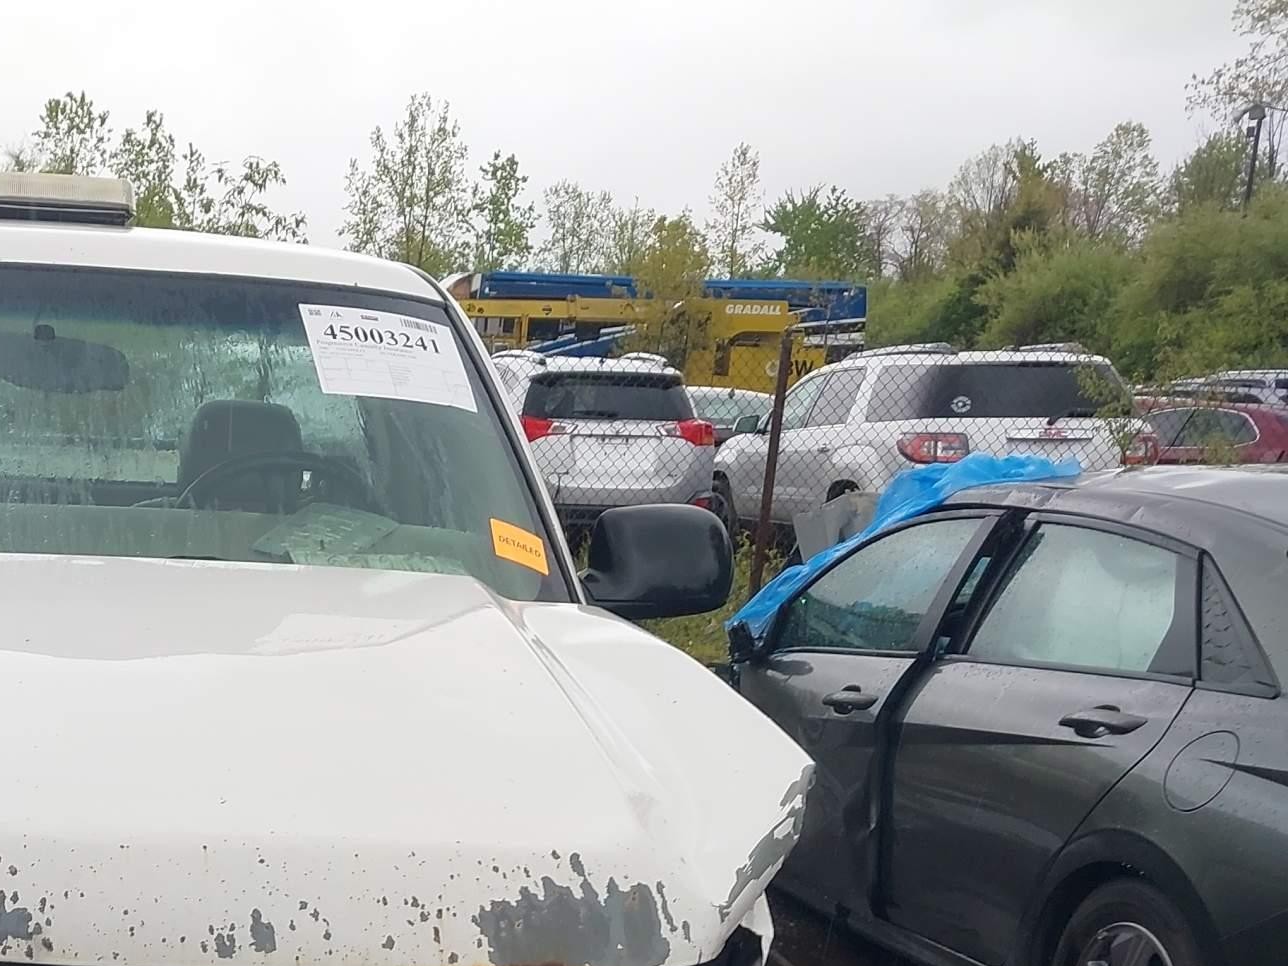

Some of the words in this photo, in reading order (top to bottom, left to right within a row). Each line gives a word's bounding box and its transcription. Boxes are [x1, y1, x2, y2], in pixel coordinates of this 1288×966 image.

[725, 304, 782, 315] GRADALL
[323, 323, 441, 354] 45003241
[498, 535, 541, 558] DETAILED
